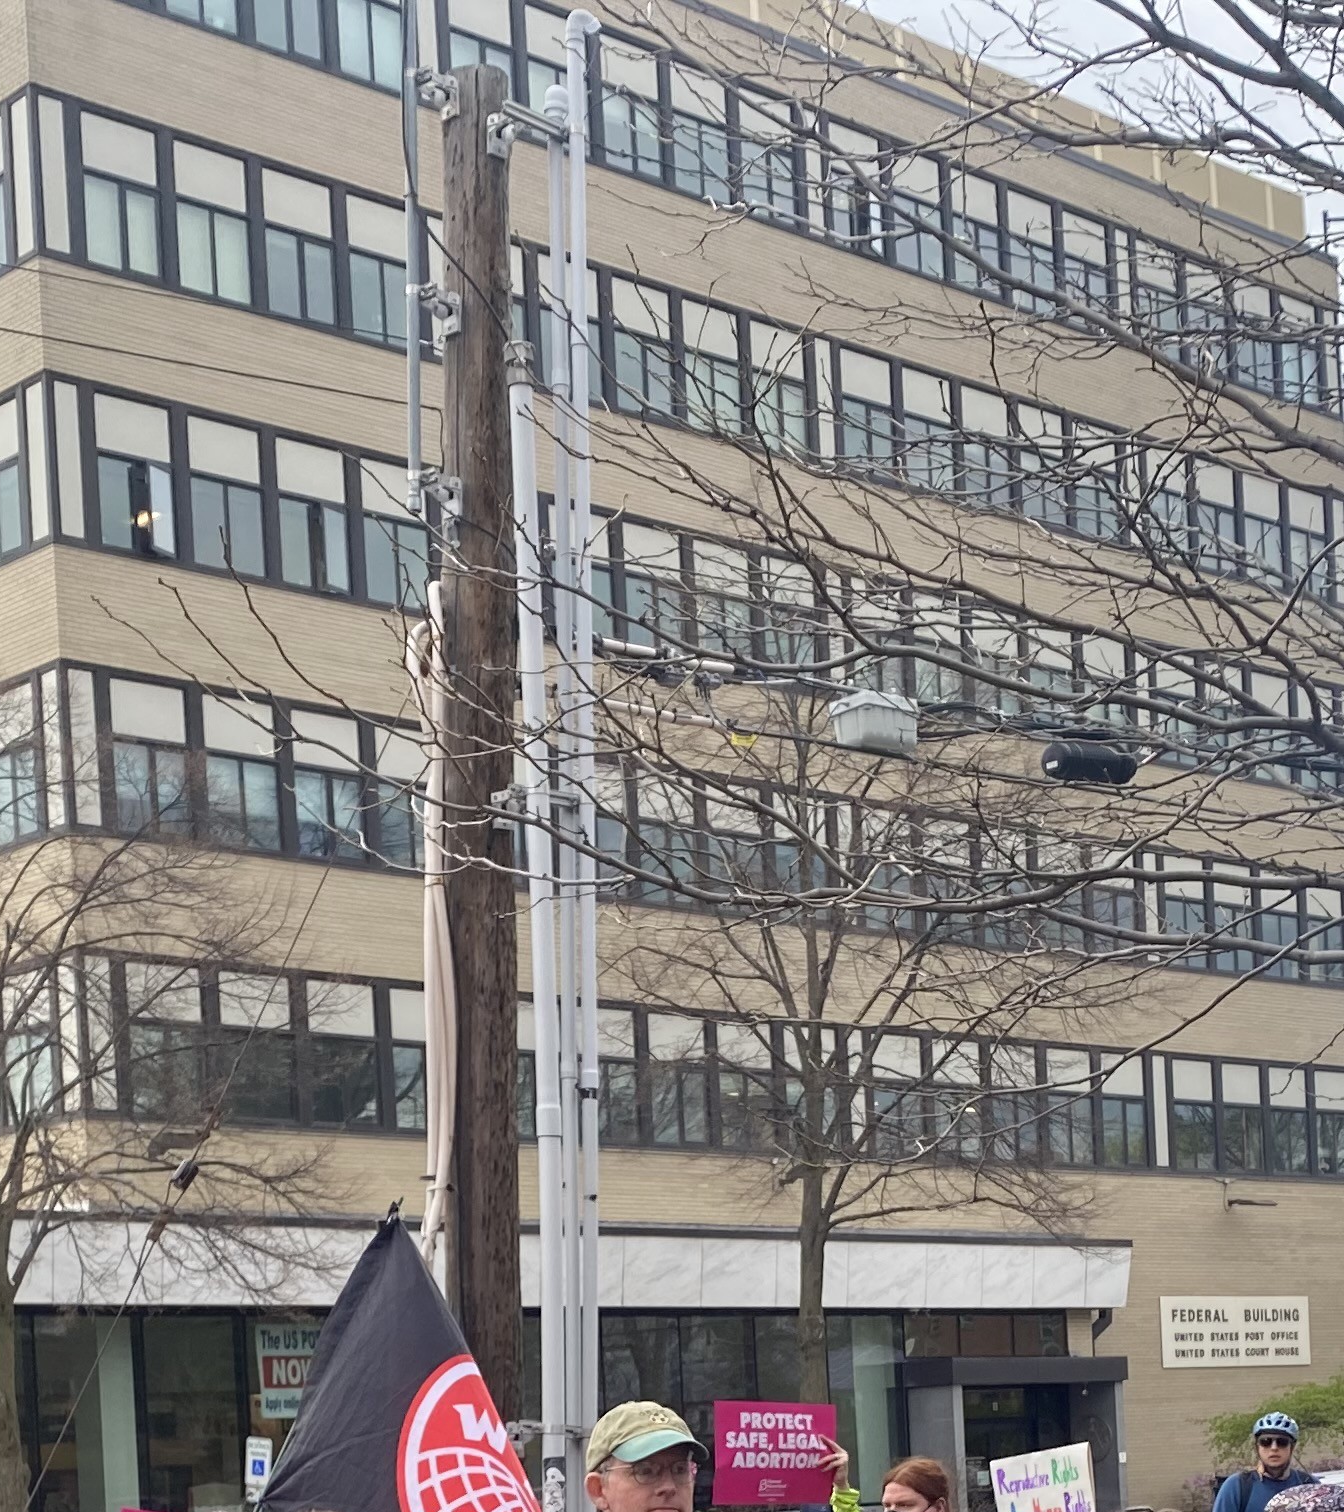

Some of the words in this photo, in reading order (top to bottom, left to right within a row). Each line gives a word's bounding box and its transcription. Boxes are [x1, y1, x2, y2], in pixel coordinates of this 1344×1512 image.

[1171, 1309, 1229, 1323] FEDERAL
[1244, 1308, 1300, 1322] BUILDING
[260, 1329, 280, 1350] The
[283, 1329, 298, 1350] US
[301, 1329, 321, 1350] PO
[1174, 1332, 1204, 1342] UNITED
[1210, 1332, 1239, 1341] STATES
[1245, 1331, 1264, 1341] POST
[1271, 1331, 1299, 1341] OFFICE
[1175, 1349, 1205, 1358] UNITED
[1211, 1348, 1240, 1358] STATES
[1245, 1347, 1270, 1357] COURT
[1275, 1347, 1299, 1356] HOUSE
[740, 1412, 812, 1430] PROTECT
[726, 1431, 774, 1451] SAFE,
[732, 1452, 821, 1469] ABORTION
[1051, 1455, 1079, 1488] Rights
